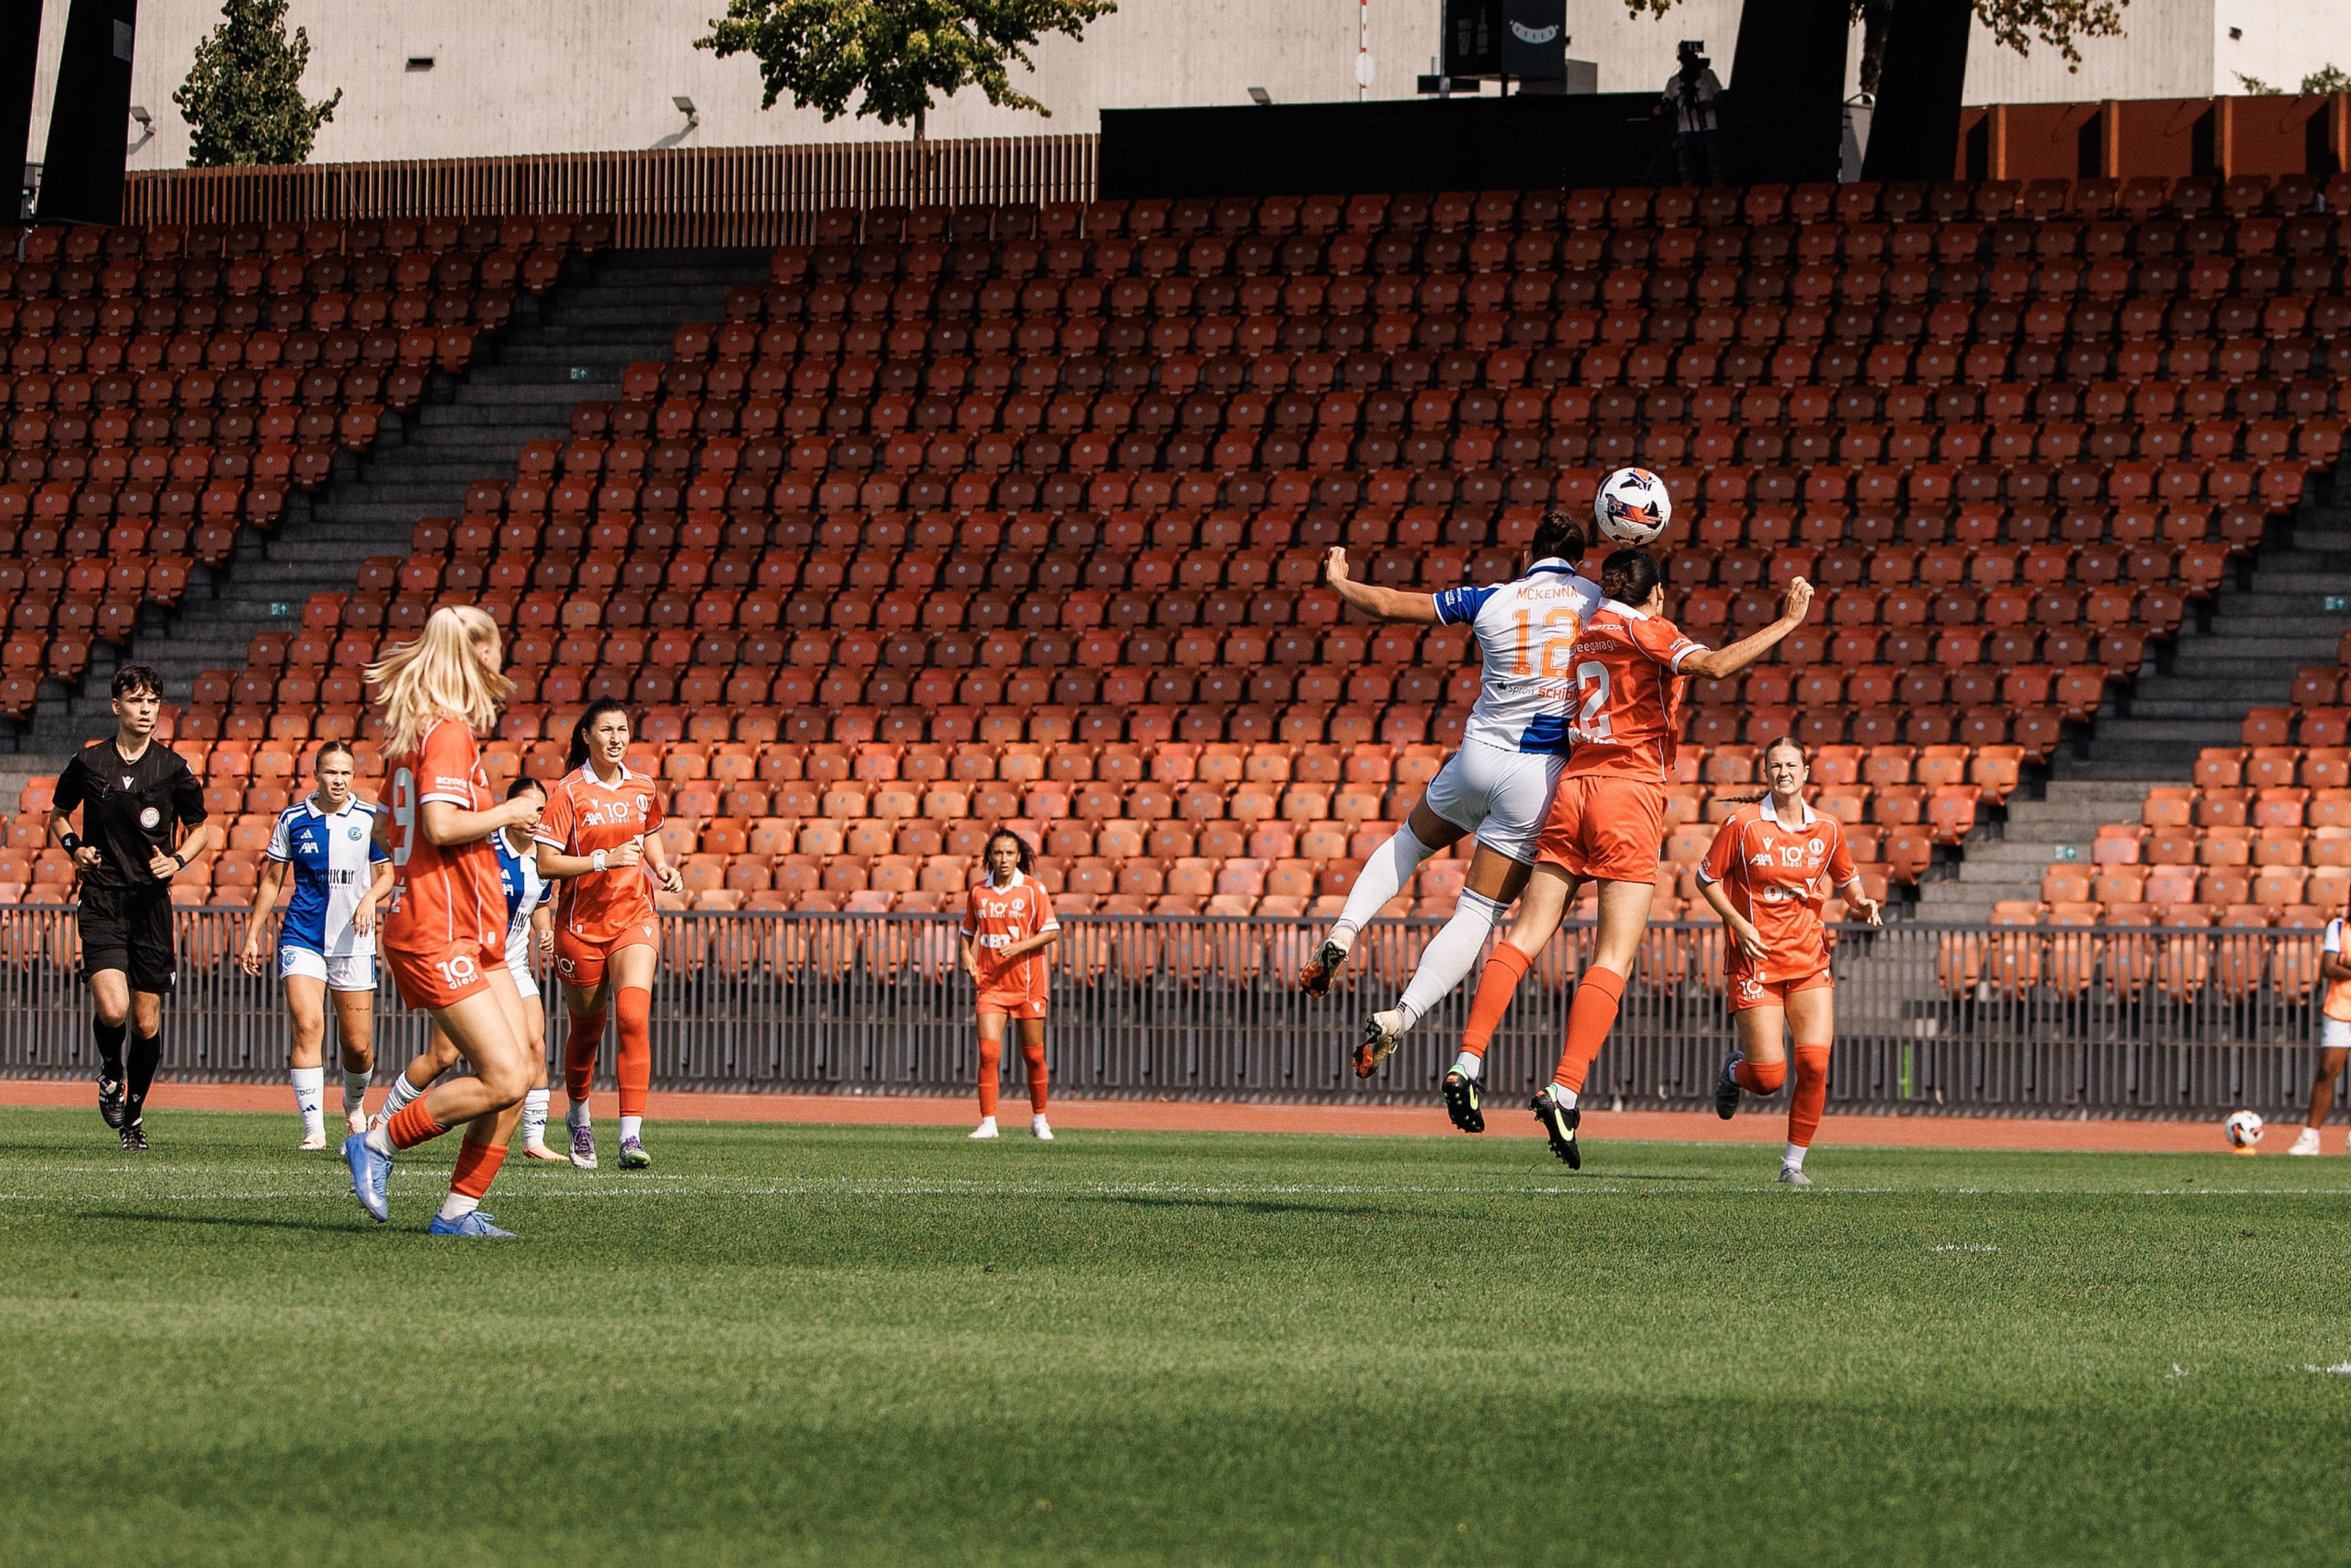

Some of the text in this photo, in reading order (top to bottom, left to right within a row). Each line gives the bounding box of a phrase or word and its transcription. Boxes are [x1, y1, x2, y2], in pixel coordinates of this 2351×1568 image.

[1517, 585, 1578, 600] MCKENNA
[1512, 606, 1583, 679] 12
[1577, 661, 1613, 738] 2
[393, 768, 415, 866] 9
[581, 812, 606, 827] AXA
[299, 842, 319, 854] AXA
[1749, 853, 1774, 867] AXA
